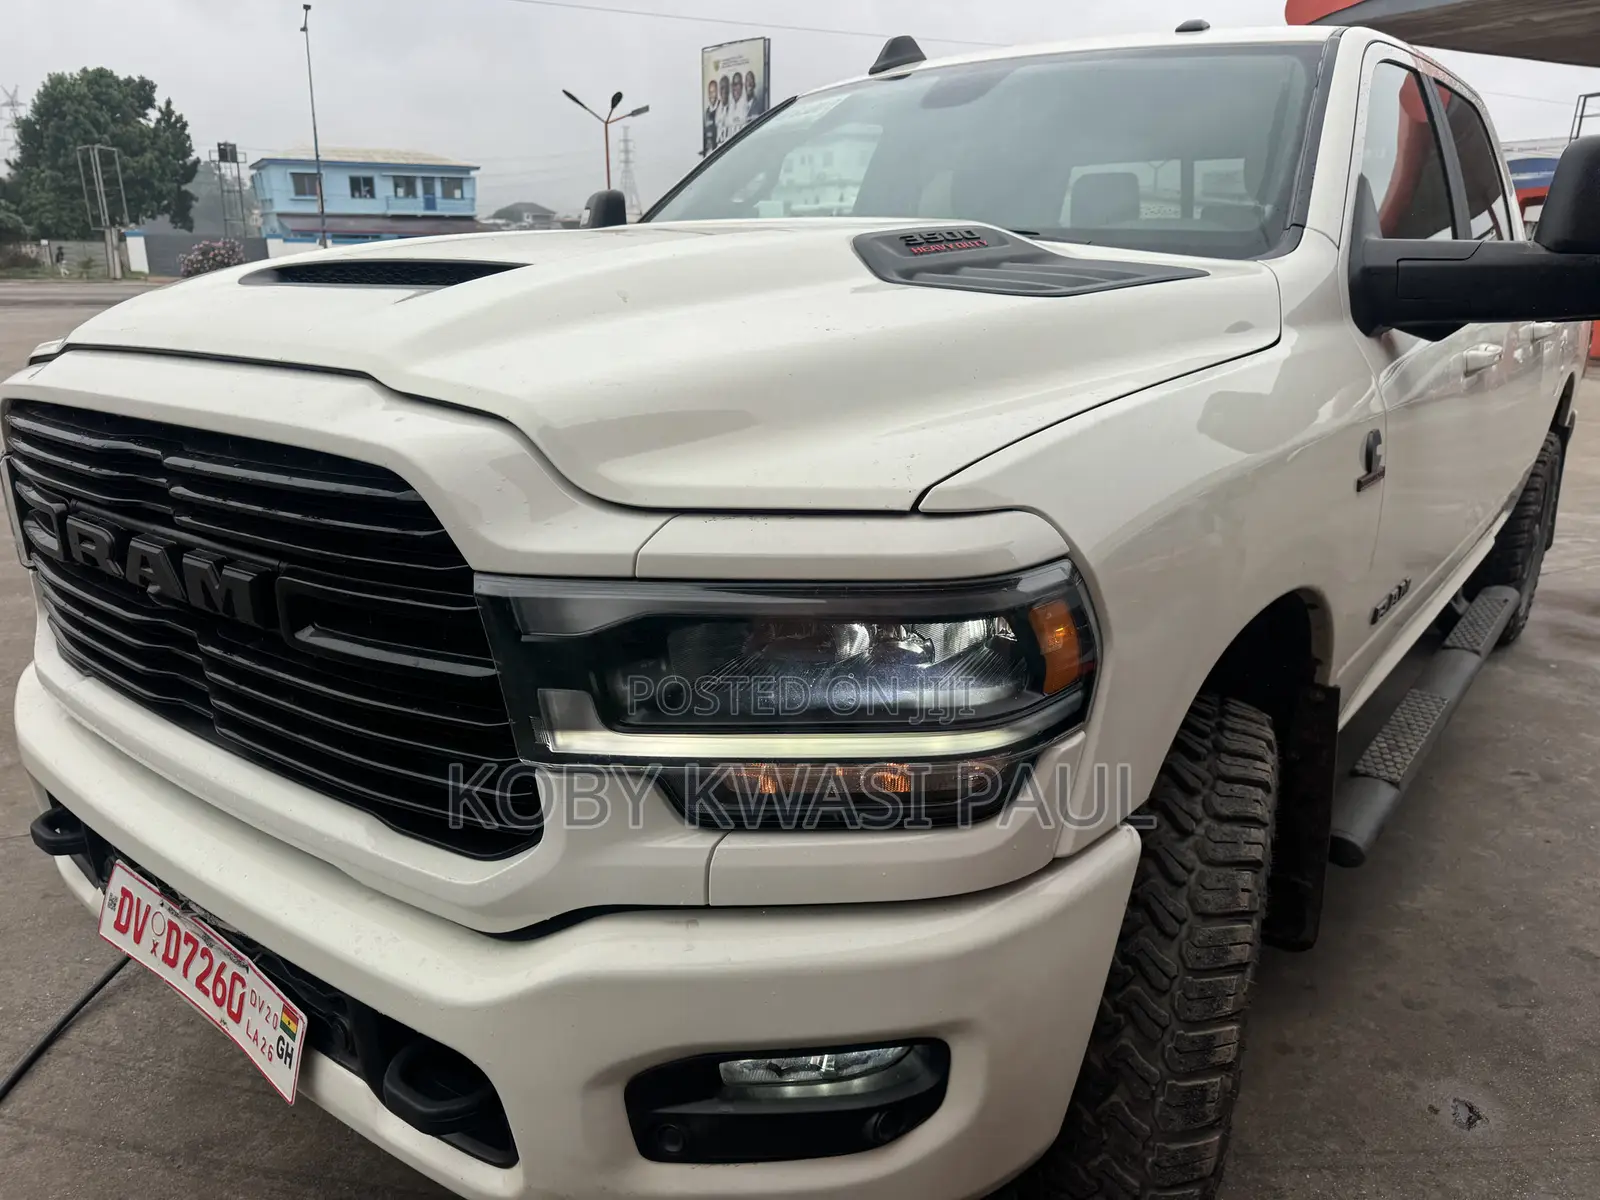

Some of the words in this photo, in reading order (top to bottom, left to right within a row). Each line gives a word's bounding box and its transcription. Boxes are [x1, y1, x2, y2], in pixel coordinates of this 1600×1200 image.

[899, 230, 981, 247] 3500
[911, 243, 955, 256] HEAVY
[956, 239, 989, 251] DUTY
[66, 511, 270, 632] RAM
[113, 885, 152, 945] DV
[161, 918, 248, 1025] D7260
[276, 1034, 295, 1071] GH
